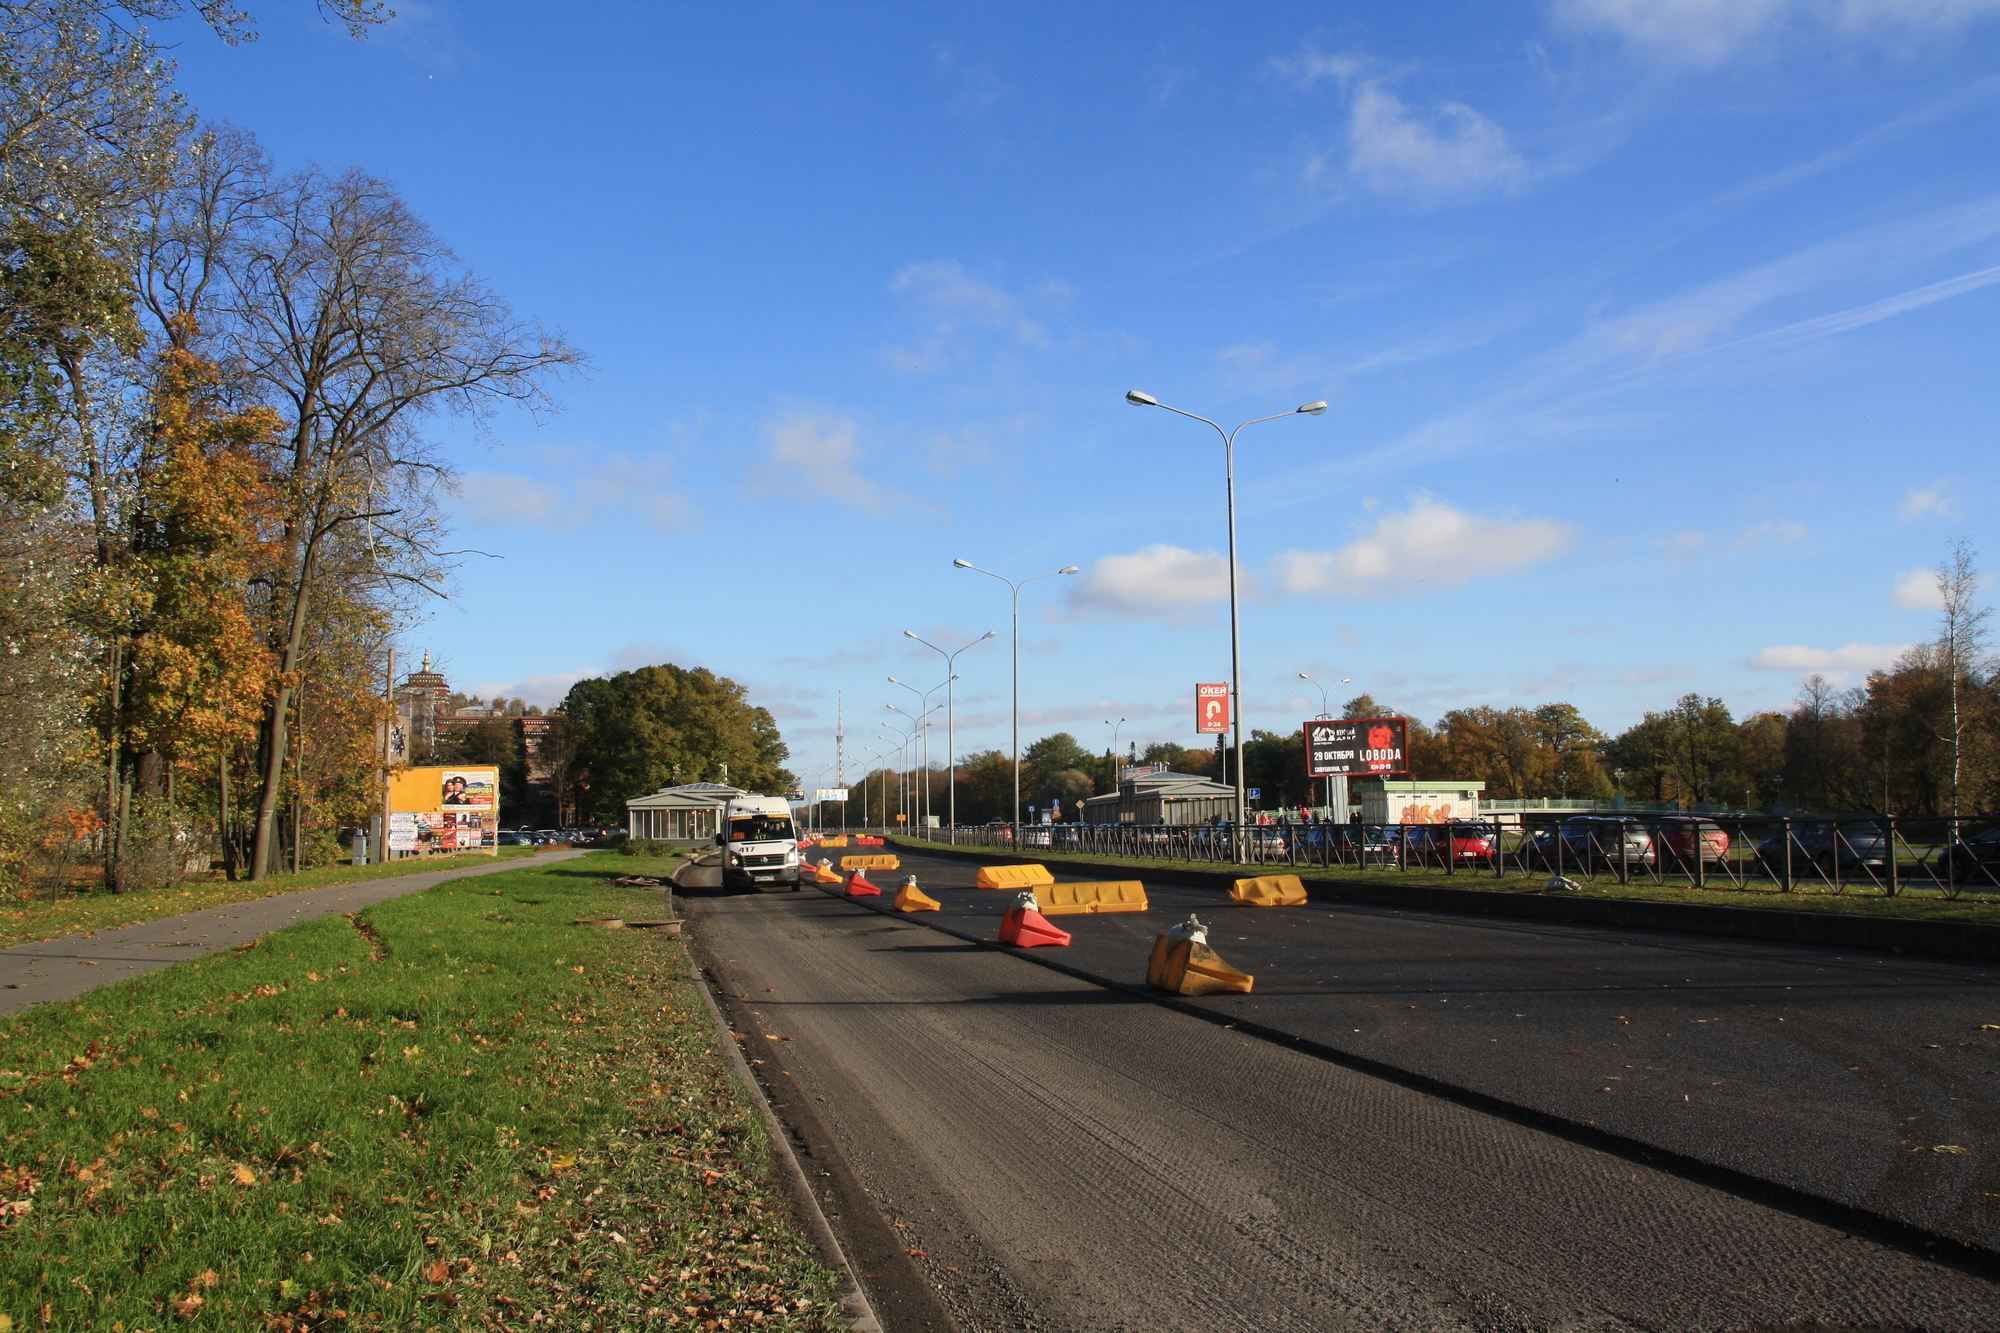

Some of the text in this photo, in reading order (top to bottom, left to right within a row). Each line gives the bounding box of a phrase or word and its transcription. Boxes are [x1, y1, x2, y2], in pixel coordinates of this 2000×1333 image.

[1314, 750, 1354, 760] 29 ОКТЯБРЯ
[1360, 748, 1401, 761] LOBODA
